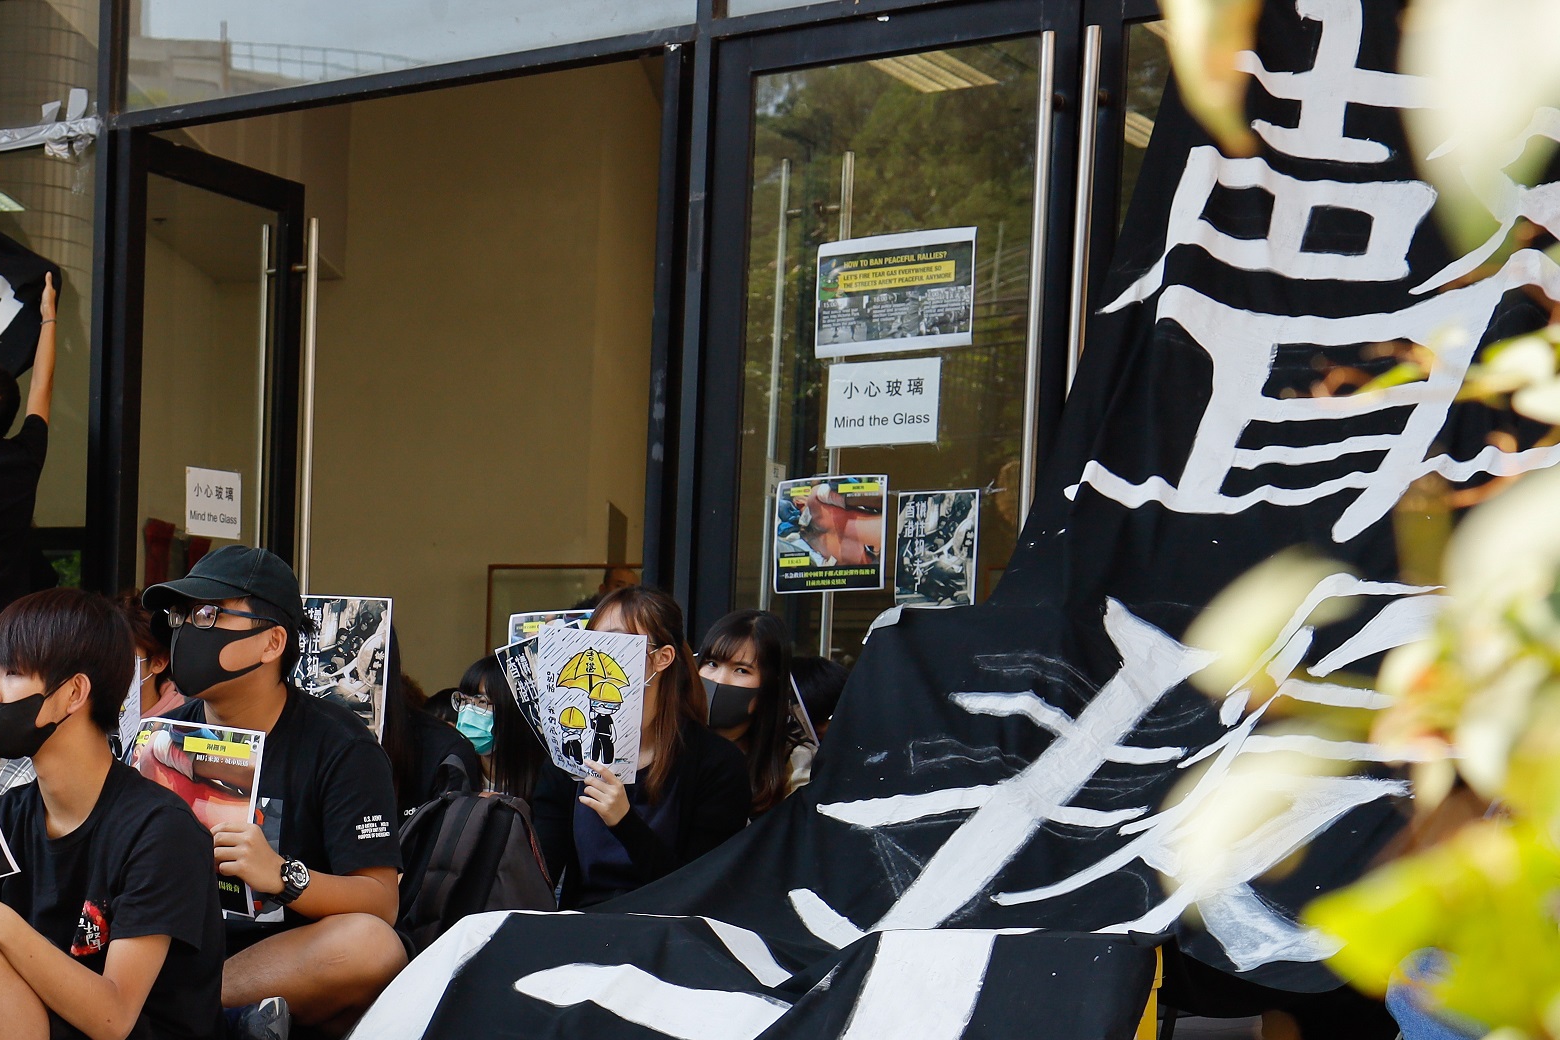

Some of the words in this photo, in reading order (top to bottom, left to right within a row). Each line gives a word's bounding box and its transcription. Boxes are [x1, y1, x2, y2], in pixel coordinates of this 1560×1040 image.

[843, 260, 858, 268] HOW
[860, 259, 869, 267] TO
[869, 258, 883, 266] BAN
[884, 255, 916, 265] PEACEFUL
[917, 251, 947, 262] RALLIES?
[843, 273, 857, 281] LET'S
[898, 266, 934, 275] EVERYWHERE
[854, 279, 877, 288] STREETS
[878, 277, 897, 286] AREN'T
[898, 275, 924, 283] PEACEFUL
[926, 272, 952, 281] ANYMORE
[843, 378, 925, 400] 小心玻璃
[834, 415, 865, 428] Mind
[869, 414, 889, 427] the
[893, 412, 930, 425] Glass
[194, 483, 234, 502] 小心玻璃
[190, 510, 206, 521] Mind
[207, 512, 218, 522] the
[219, 513, 237, 525] Glass
[903, 501, 916, 558] 香港人
